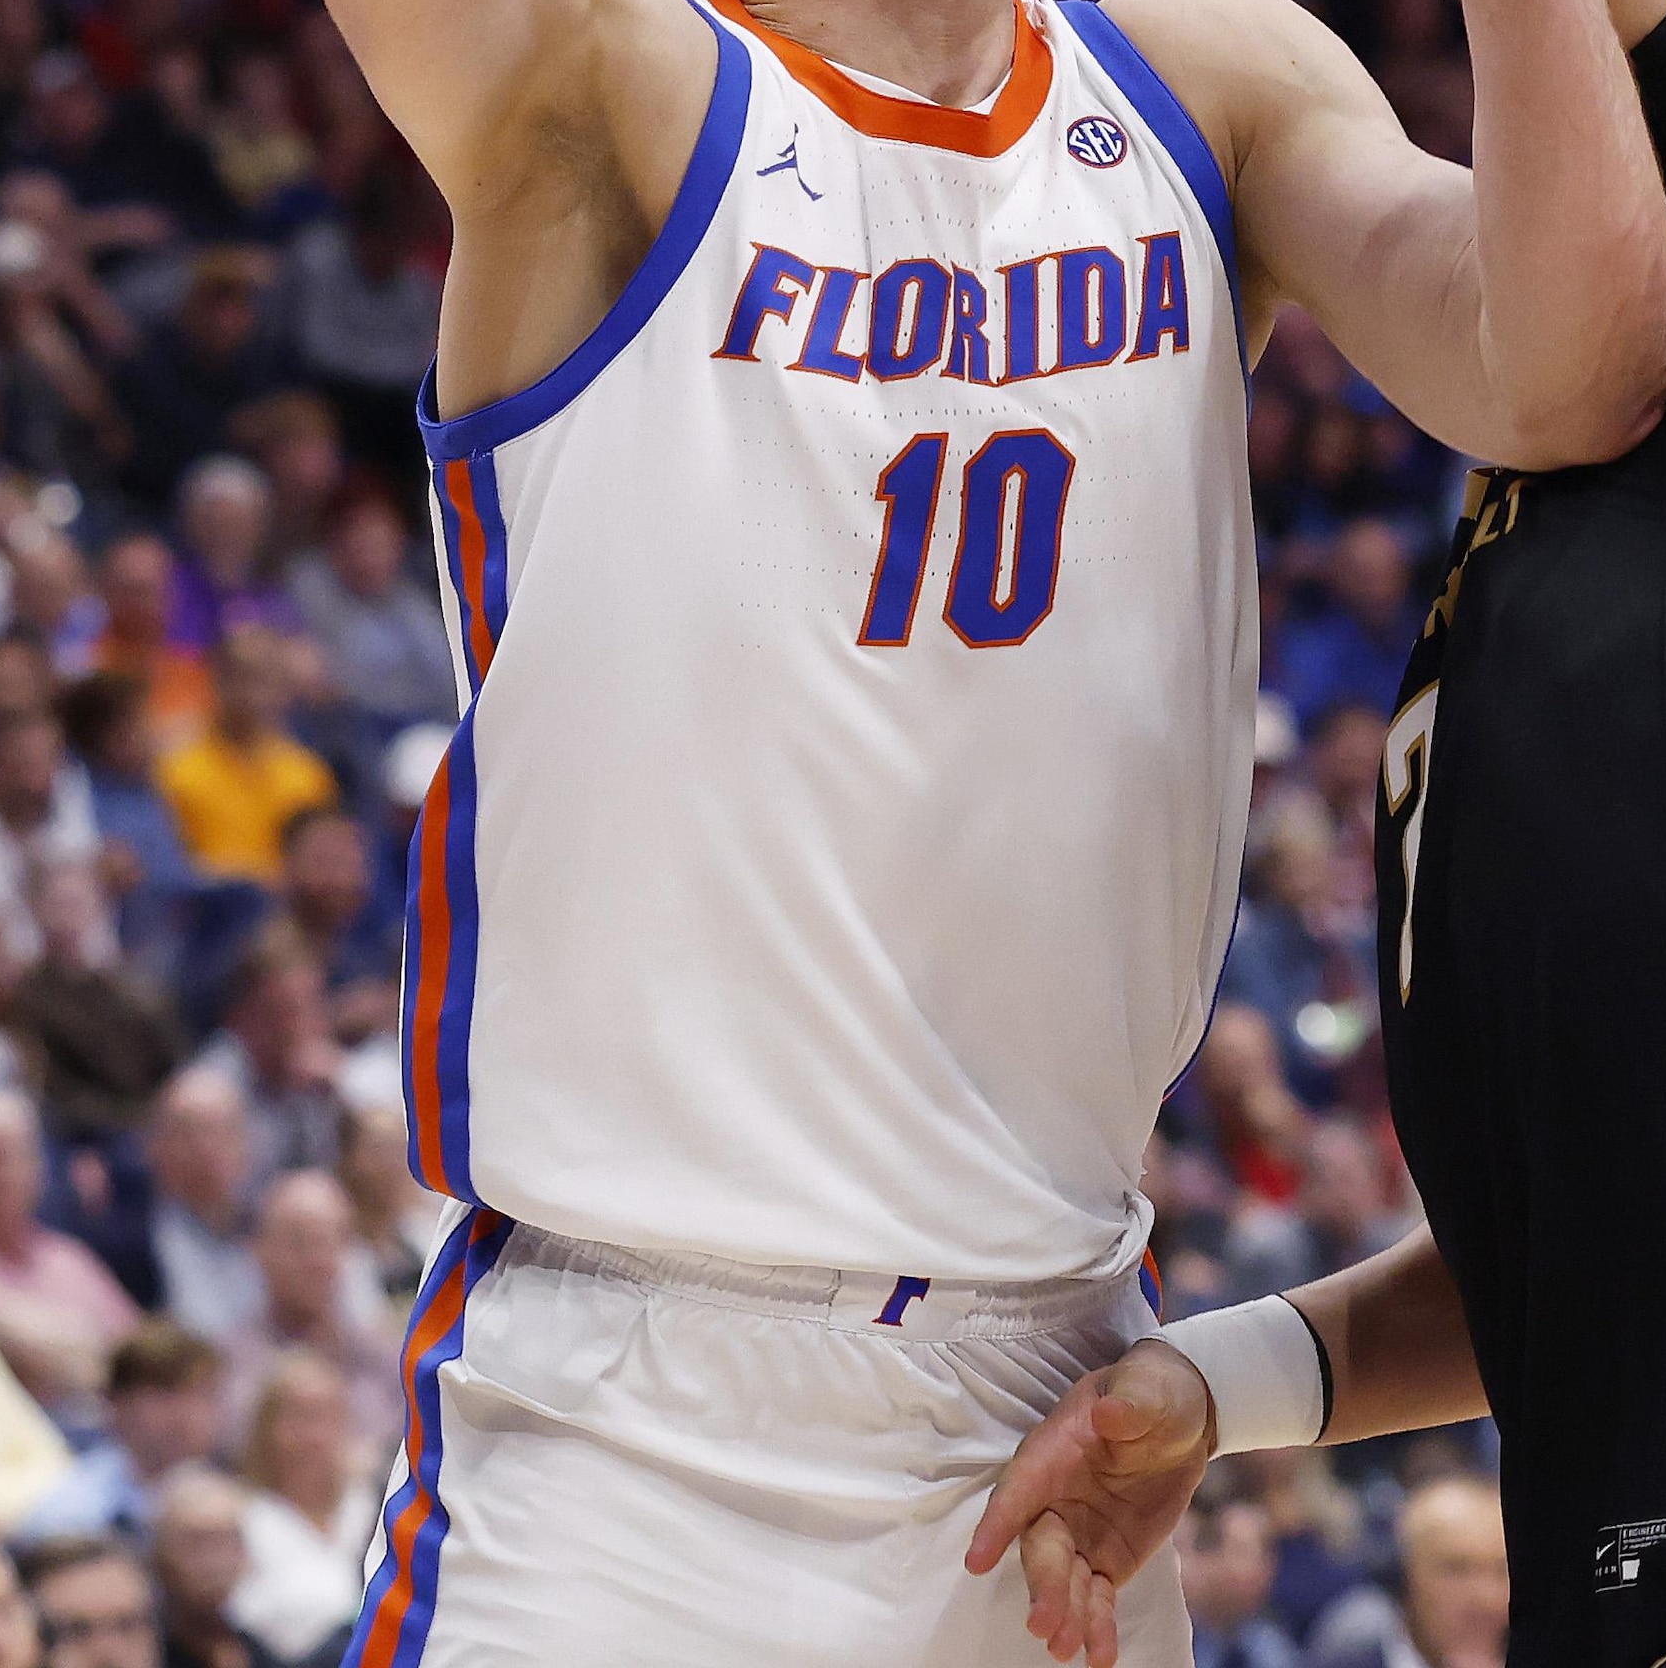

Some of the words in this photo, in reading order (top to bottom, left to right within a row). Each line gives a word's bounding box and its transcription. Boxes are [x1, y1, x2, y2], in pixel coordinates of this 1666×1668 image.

[1068, 119, 1124, 165] SEC
[711, 230, 1191, 387] FLORIDA
[857, 428, 1076, 649] 10
